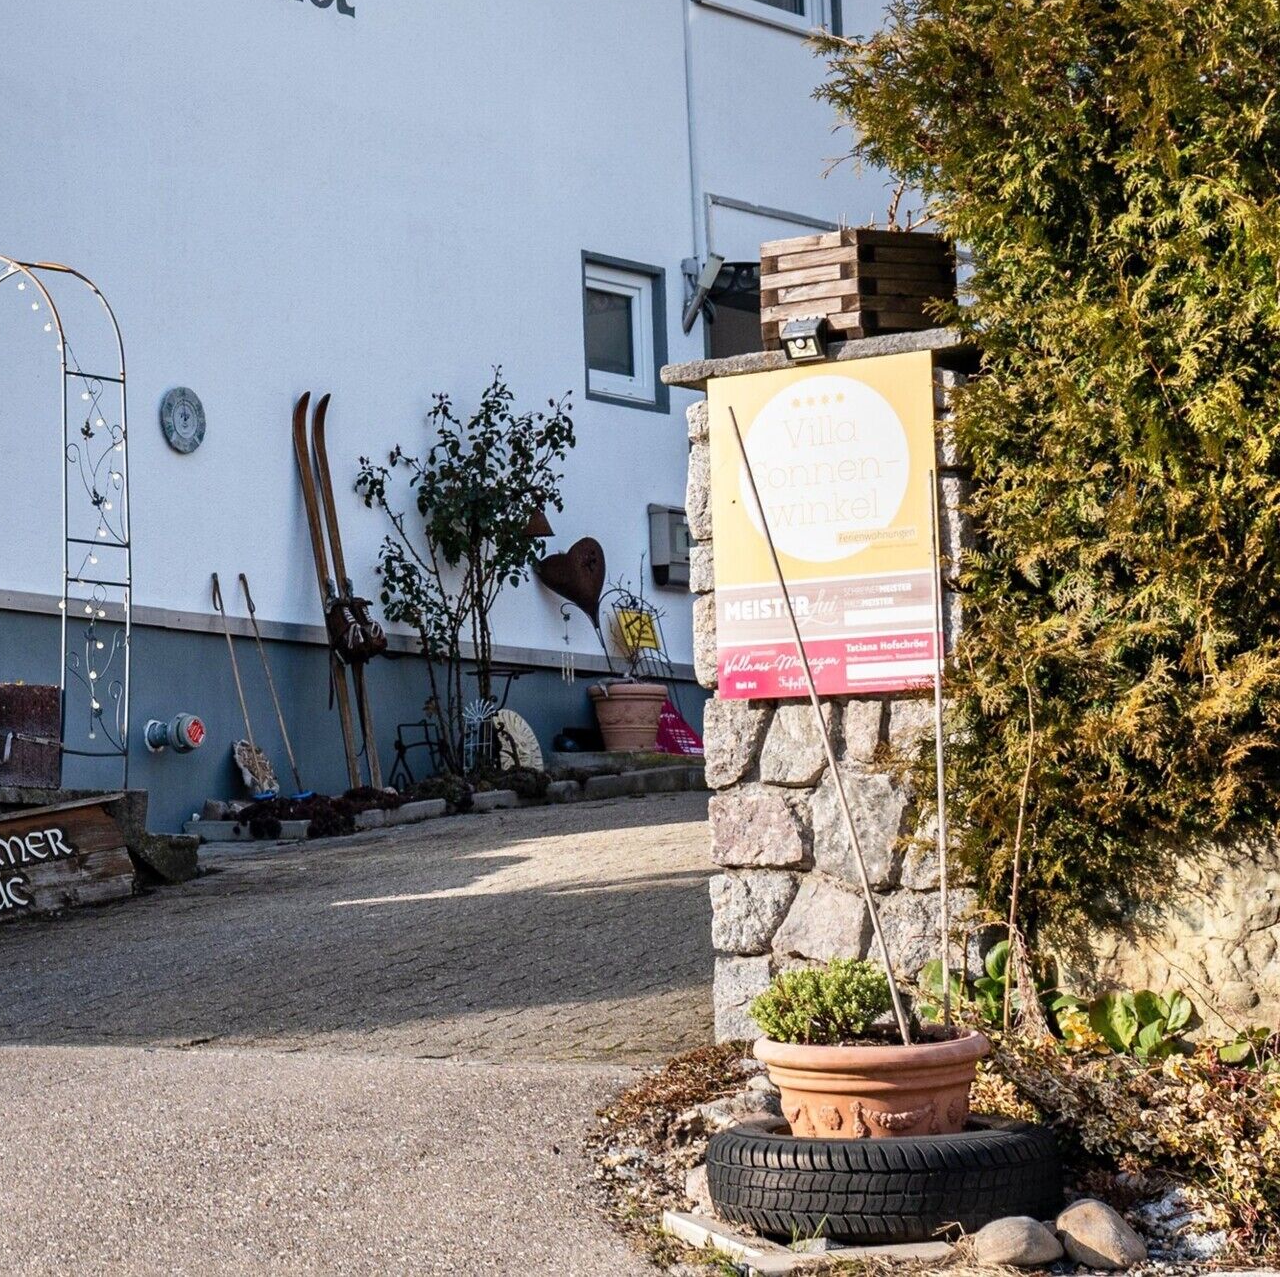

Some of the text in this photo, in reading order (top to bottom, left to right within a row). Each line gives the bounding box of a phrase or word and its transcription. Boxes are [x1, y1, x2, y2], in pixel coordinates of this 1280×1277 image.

[782, 415, 860, 449] Villa
[768, 488, 881, 530] winkel
[838, 528, 916, 544] Ferienwohnungen
[724, 653, 840, 677] Wellness-Maagen
